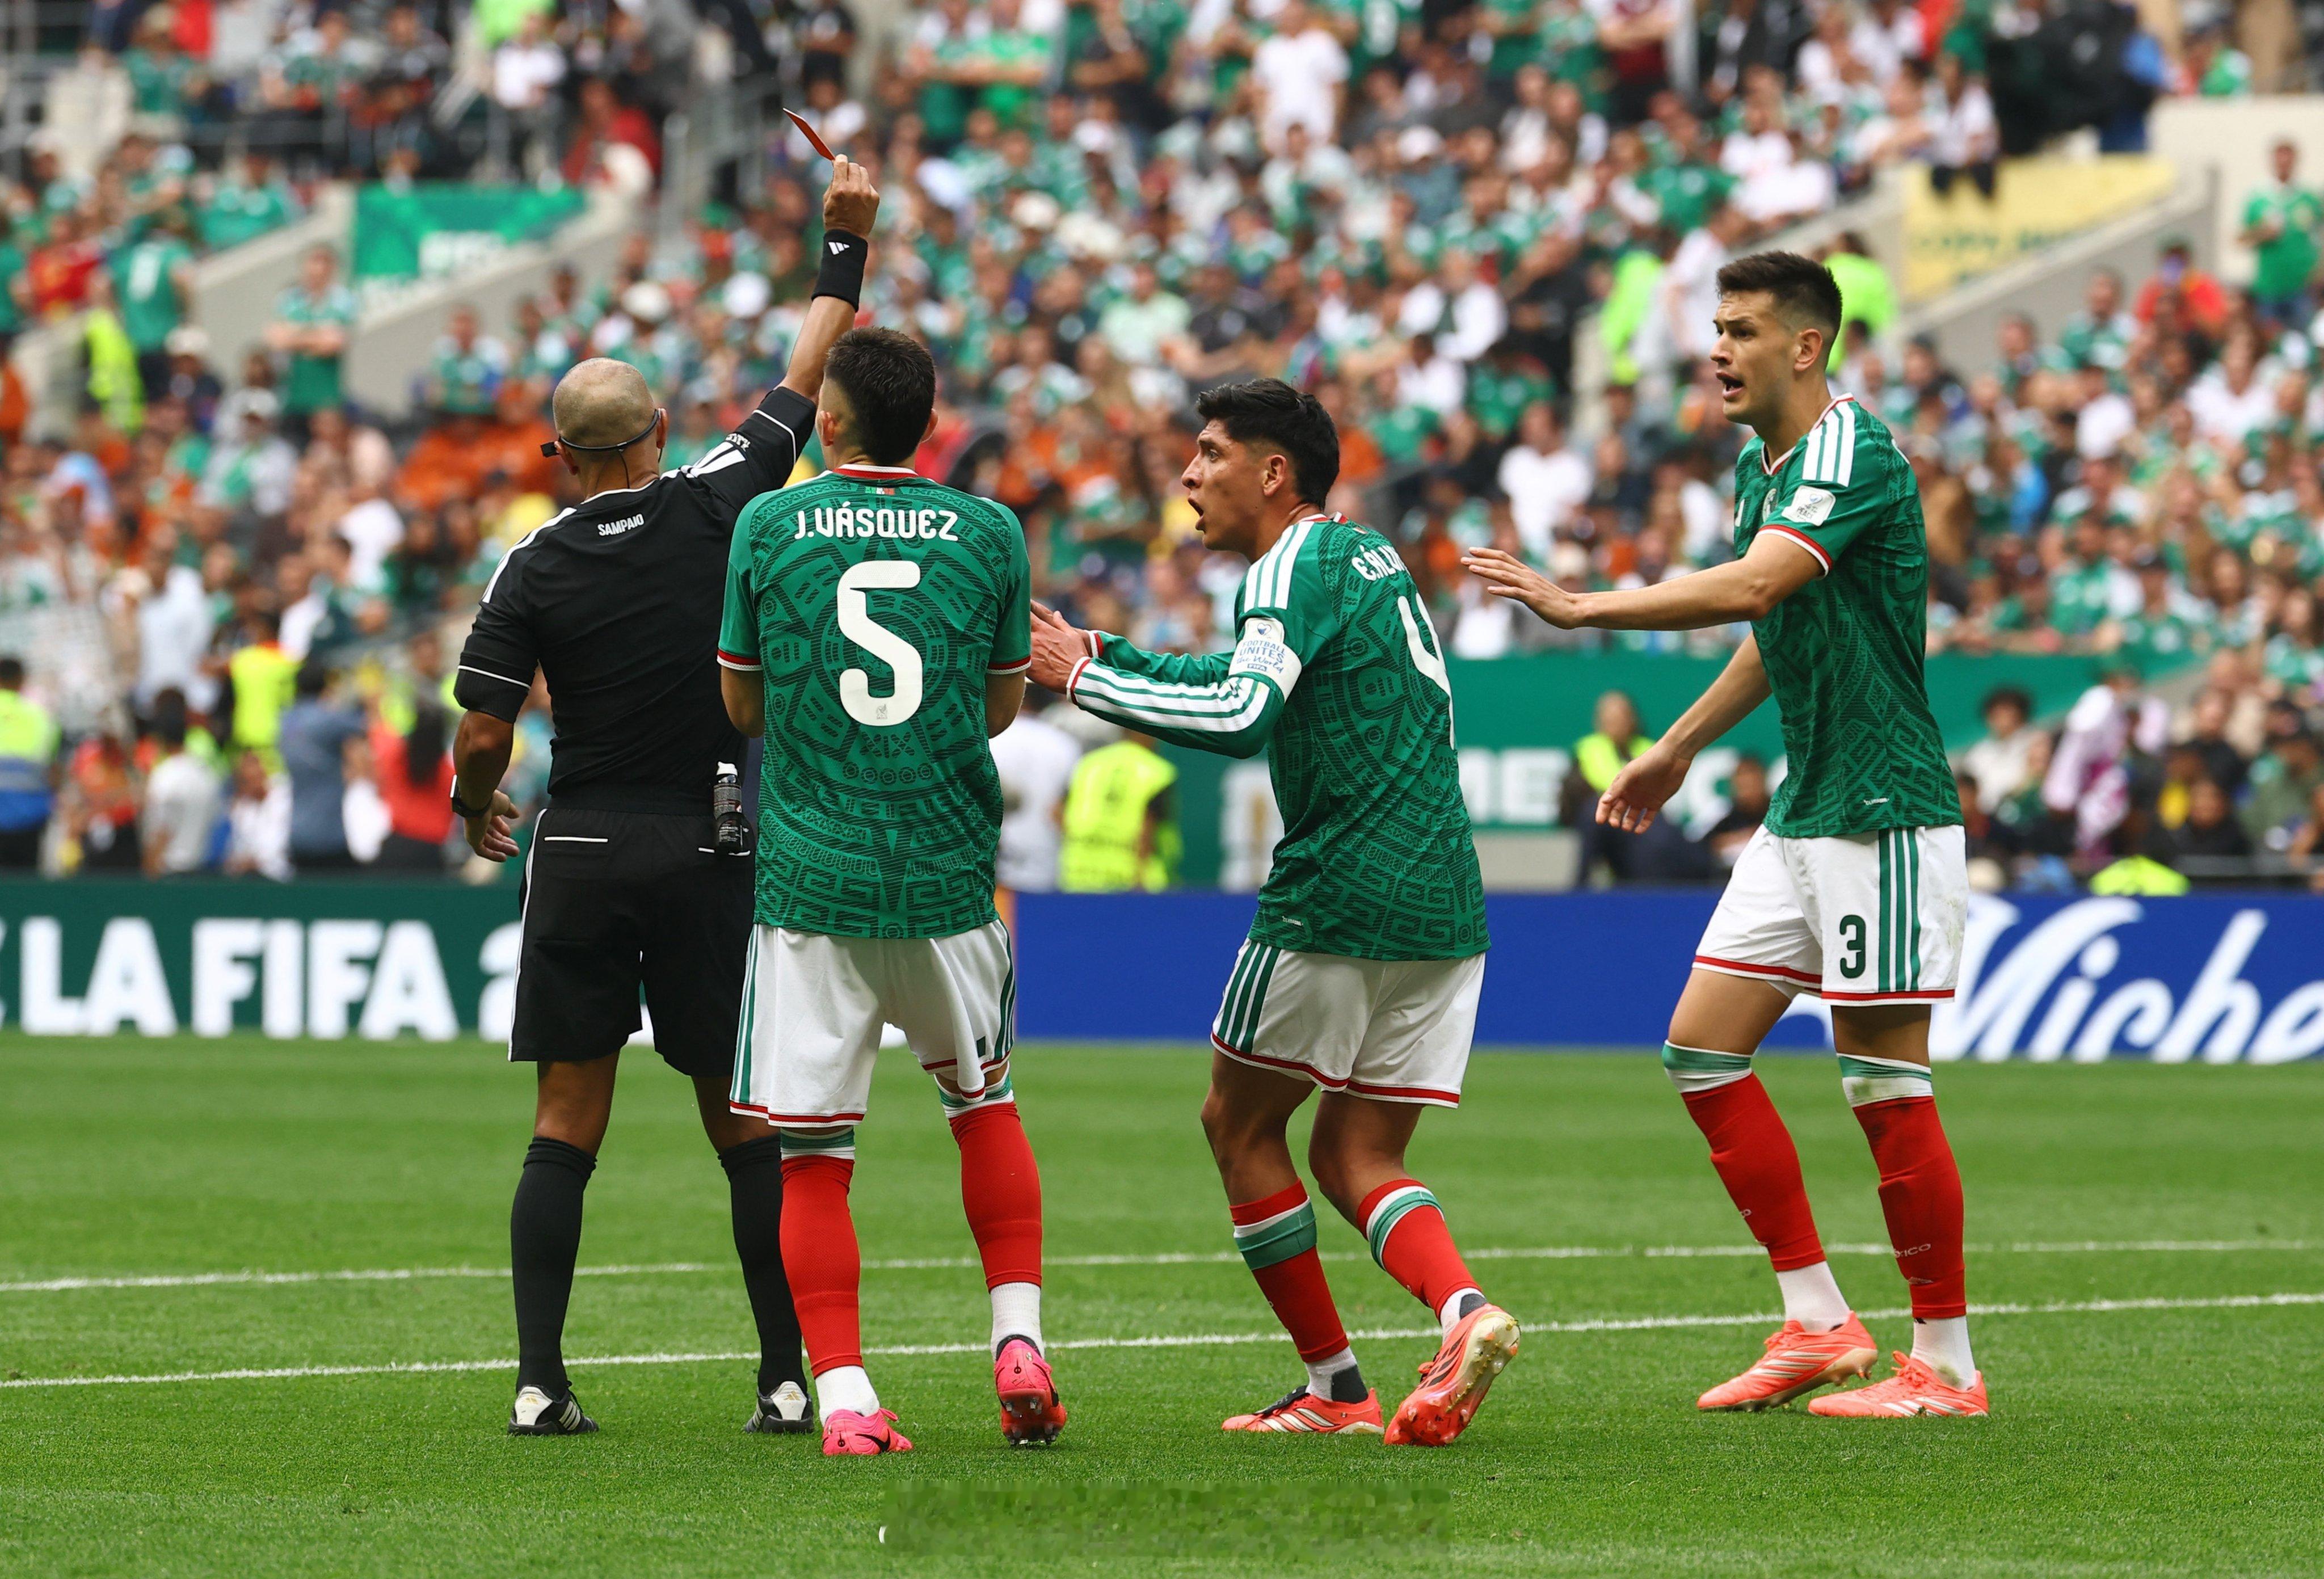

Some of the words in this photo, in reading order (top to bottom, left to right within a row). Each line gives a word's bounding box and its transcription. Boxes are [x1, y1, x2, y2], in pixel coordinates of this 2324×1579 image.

[597, 513, 644, 536] SAMPAIO
[794, 501, 958, 541] J.VÁSQUEZ
[837, 560, 923, 726] 5
[1240, 647, 1284, 663] UNITES
[1243, 640, 1285, 655] FOOTBALL
[1253, 655, 1284, 673] World
[1397, 593, 1454, 750] 4
[1839, 915, 1866, 979] 3
[20, 915, 178, 1036] LA
[191, 917, 457, 1041] FIFA
